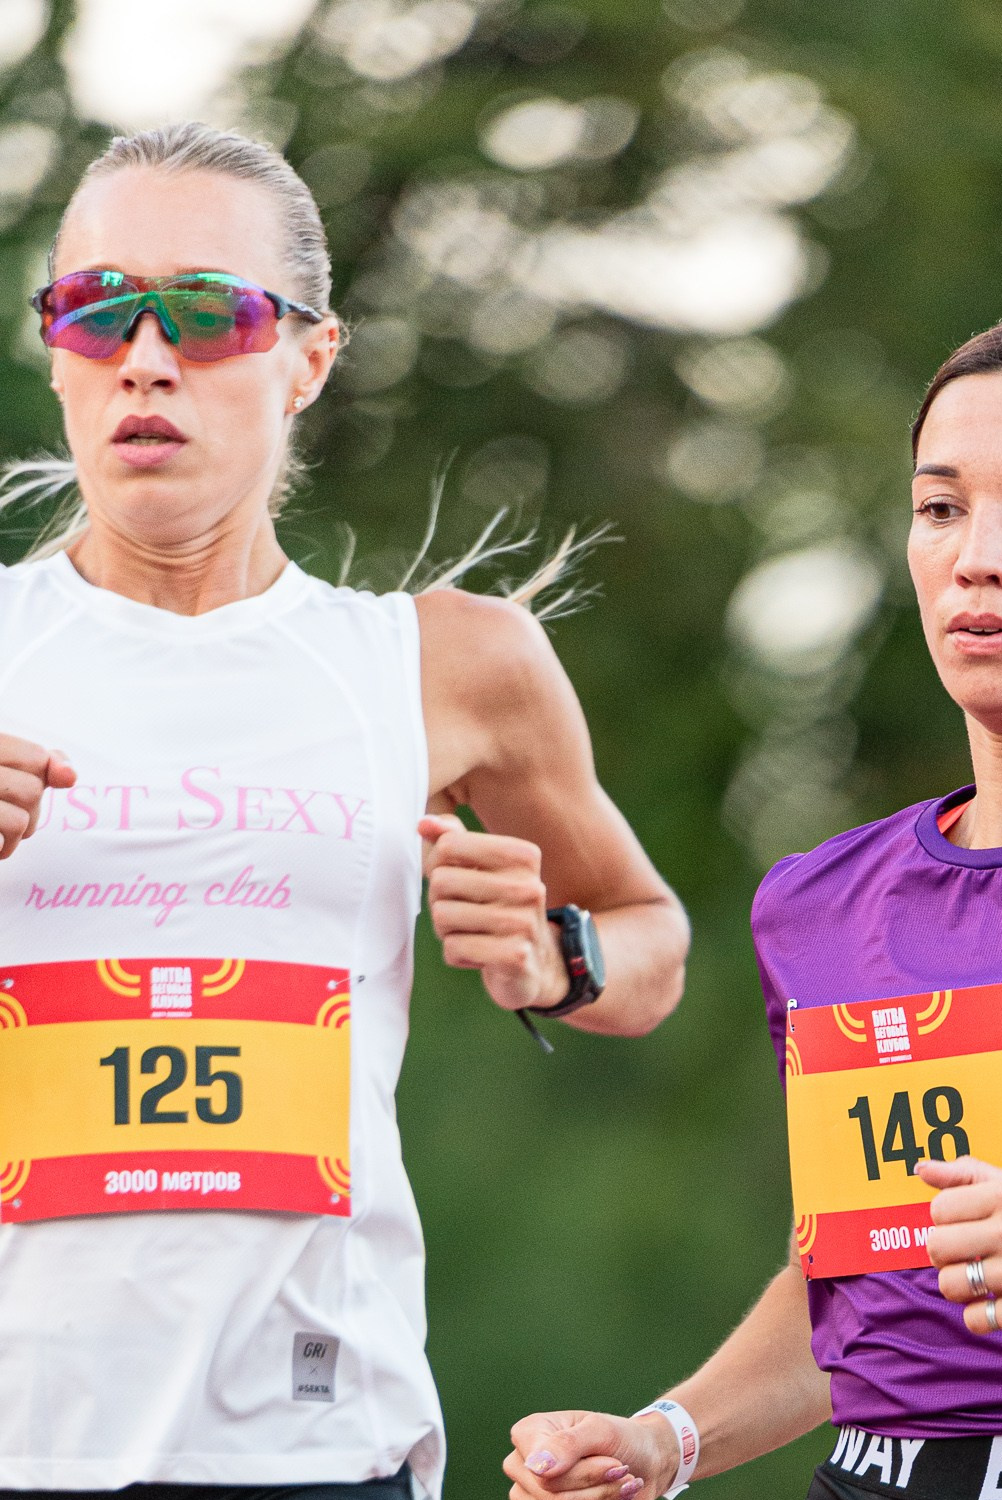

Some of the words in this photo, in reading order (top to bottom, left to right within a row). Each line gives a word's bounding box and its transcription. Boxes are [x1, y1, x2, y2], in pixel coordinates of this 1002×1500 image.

[177, 766, 369, 840] SEXY
[25, 873, 188, 928] running
[203, 865, 292, 910] club
[871, 1006, 906, 1027] БИТВА
[876, 1036, 910, 1054] КЛУБОВ
[100, 1046, 243, 1125] 125
[847, 1086, 970, 1181] 148
[104, 1169, 157, 1195] 3000
[162, 1170, 241, 1195] метров
[869, 1225, 911, 1252] 3000
[303, 1342, 328, 1358] GRI
[829, 1423, 926, 1488] WAY
